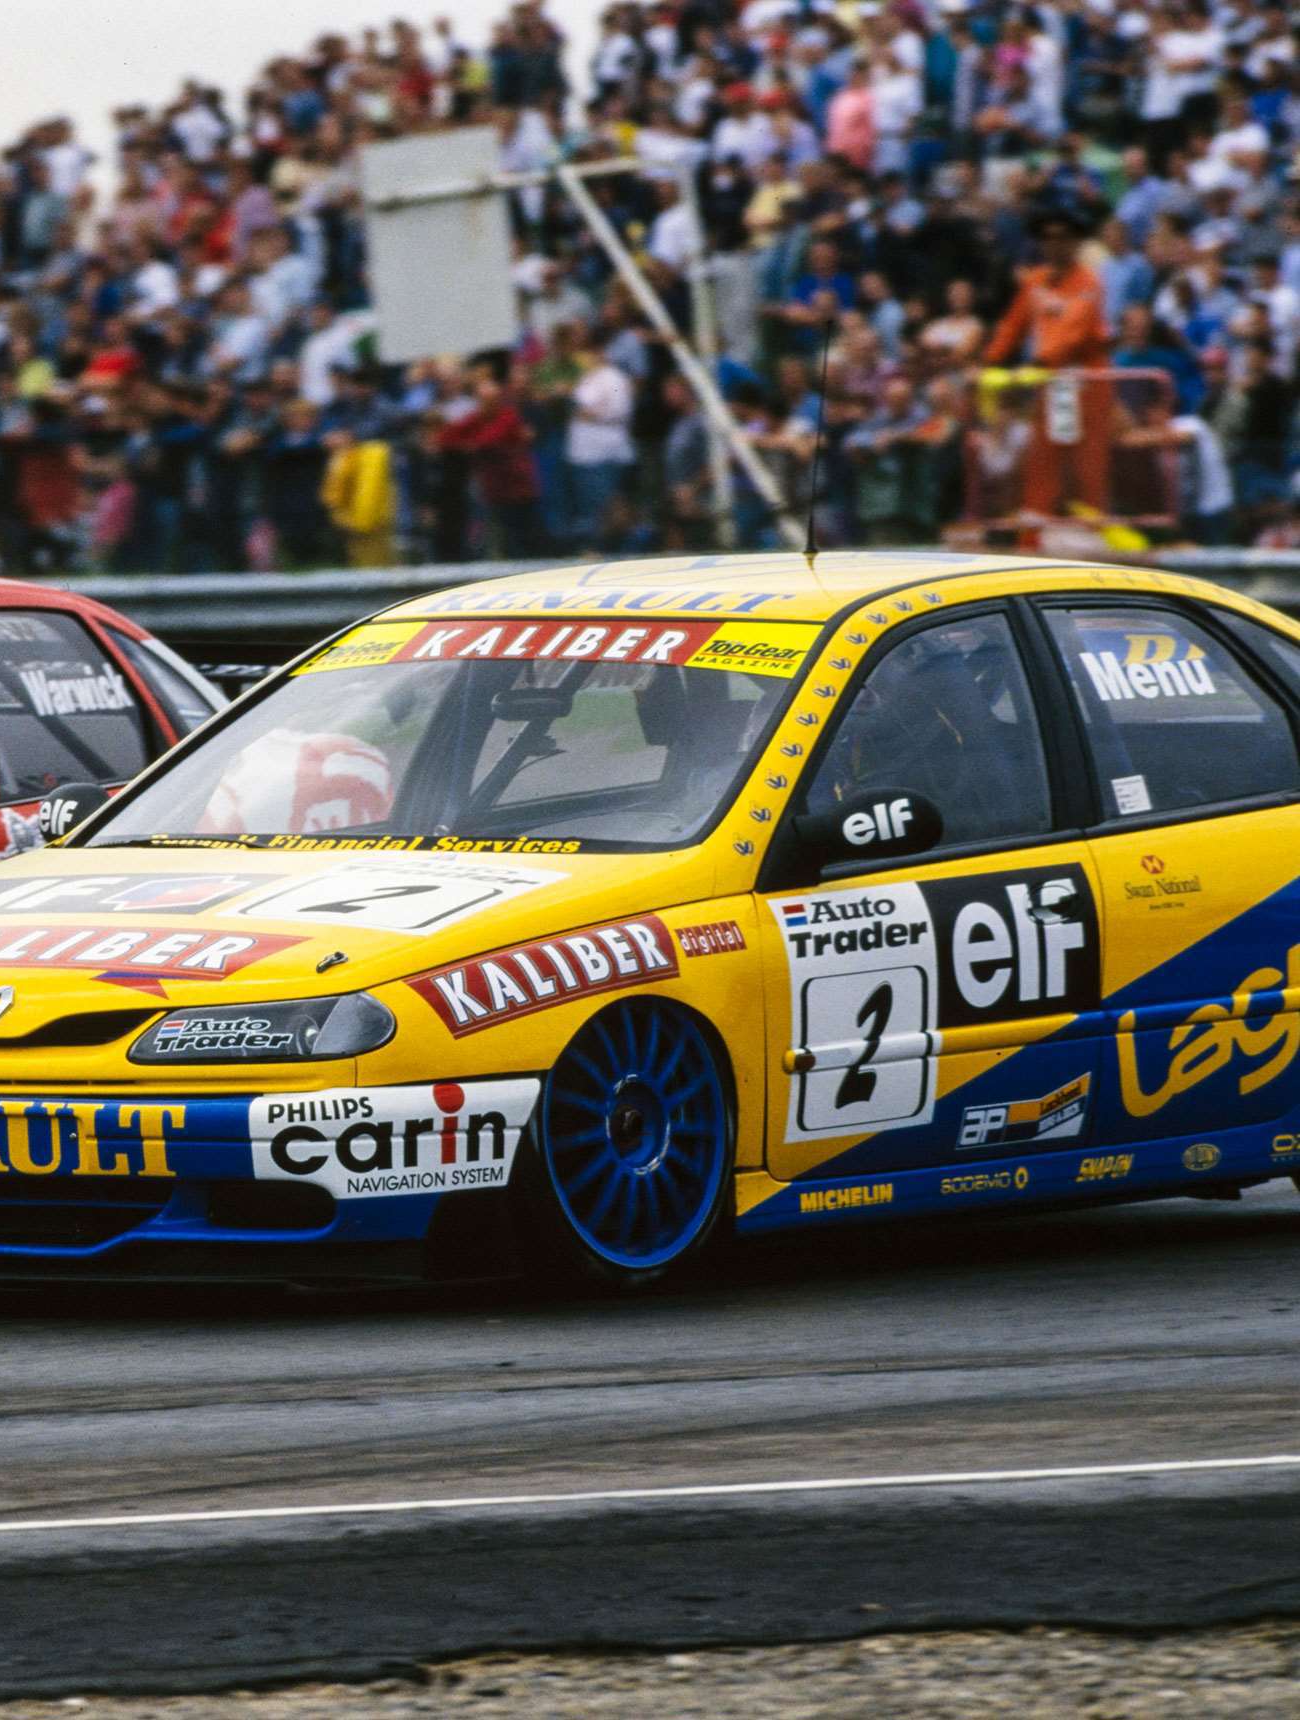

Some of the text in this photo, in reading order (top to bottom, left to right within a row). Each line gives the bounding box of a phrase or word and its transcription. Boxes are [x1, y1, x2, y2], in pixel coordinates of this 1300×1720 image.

[426, 591, 790, 614] RENAULT
[412, 626, 690, 663] KALIBER
[692, 656, 795, 669] MAGAZINE
[1079, 651, 1216, 701] Menu
[20, 662, 135, 717] Warwick
[39, 799, 78, 835] elf
[843, 798, 914, 846] elf
[268, 834, 424, 852] Financial
[431, 836, 580, 854] Services
[298, 885, 442, 914] 2
[809, 896, 897, 925] Auto
[680, 925, 743, 954] digital
[789, 919, 928, 958] Trader
[953, 870, 1086, 1008] elf
[433, 922, 670, 1026] KALIBER
[184, 1017, 271, 1033] Auto
[155, 1032, 293, 1053] Trader
[834, 980, 893, 1110] 2
[268, 1096, 374, 1123] PHILIPS
[270, 1083, 507, 1175] carin
[1272, 1134, 1300, 1151] O
[347, 1167, 504, 1194] NAVIGATION SYSTEM
[940, 1172, 1011, 1194] SODEMO
[800, 1182, 894, 1213] MICHELIN
